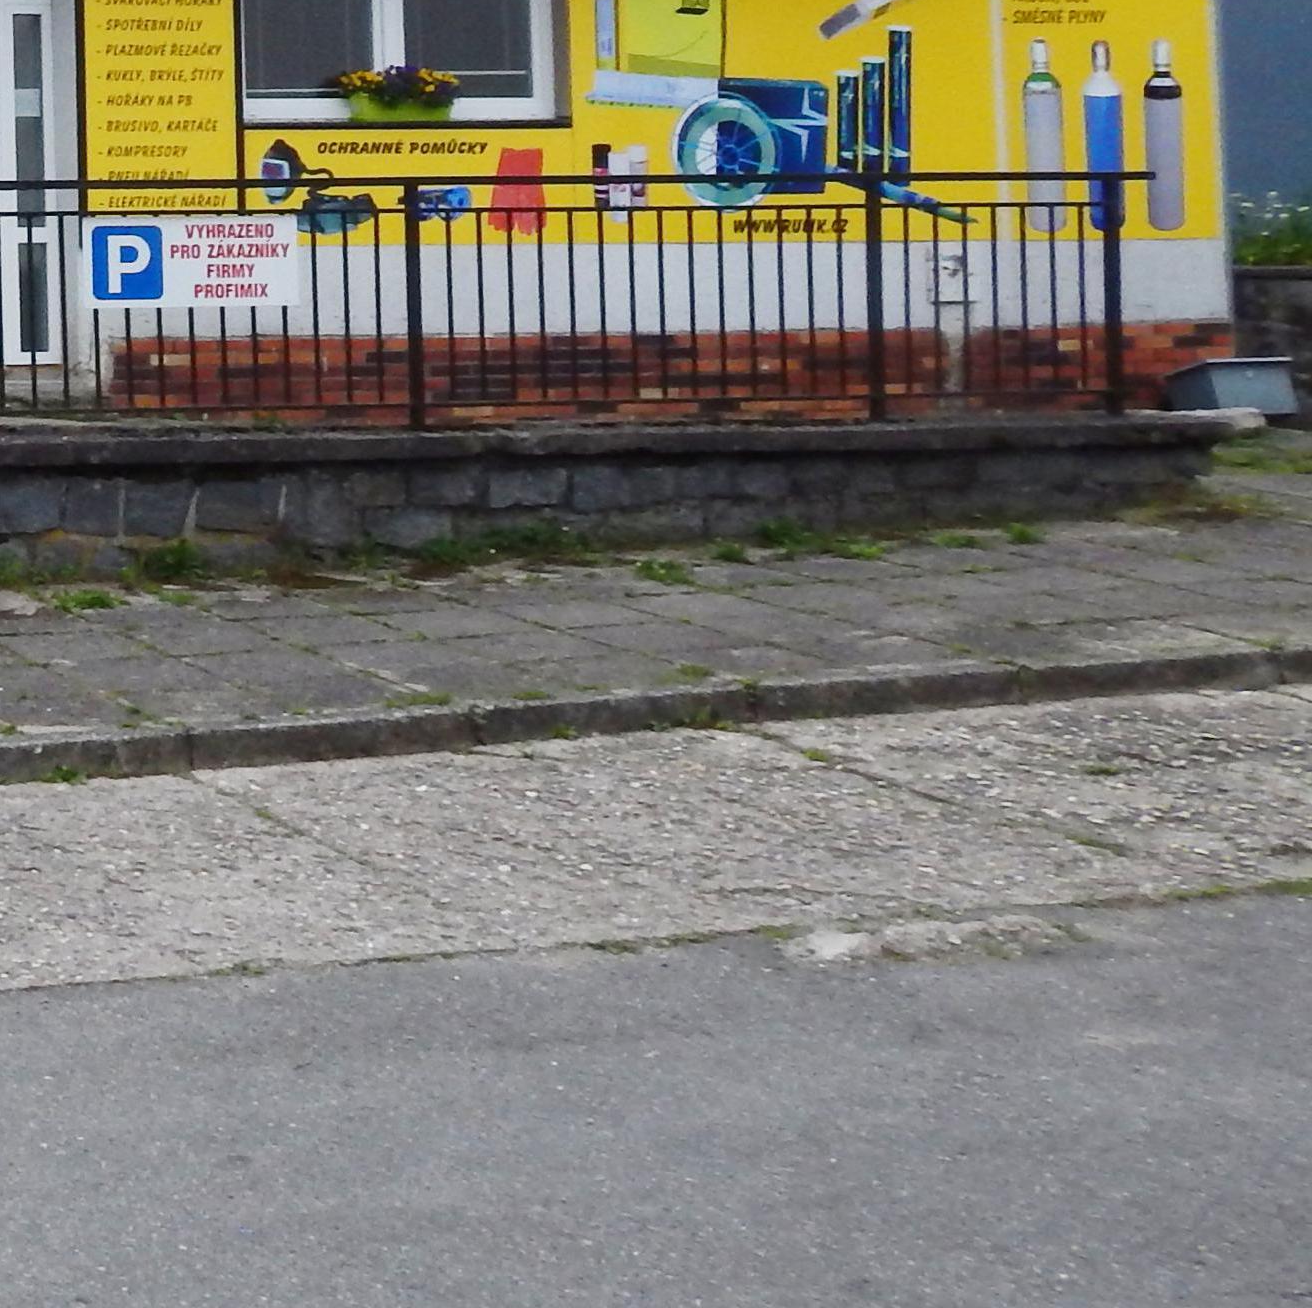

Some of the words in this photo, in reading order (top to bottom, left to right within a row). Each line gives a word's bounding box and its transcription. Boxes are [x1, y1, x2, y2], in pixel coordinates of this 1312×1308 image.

[157, 94, 174, 107] NA
[177, 94, 194, 107] PB
[107, 144, 189, 158] KOMPRESORY
[317, 138, 404, 155] OCHRANNÉ
[408, 138, 488, 155] POMŮCKY
[185, 223, 275, 239] VYHRAZENO
[169, 244, 201, 259] PRO
[207, 239, 290, 259] ZÁKAZNÍKY
[206, 263, 256, 278] FIRMY
[193, 283, 269, 299] PROFIMIX
